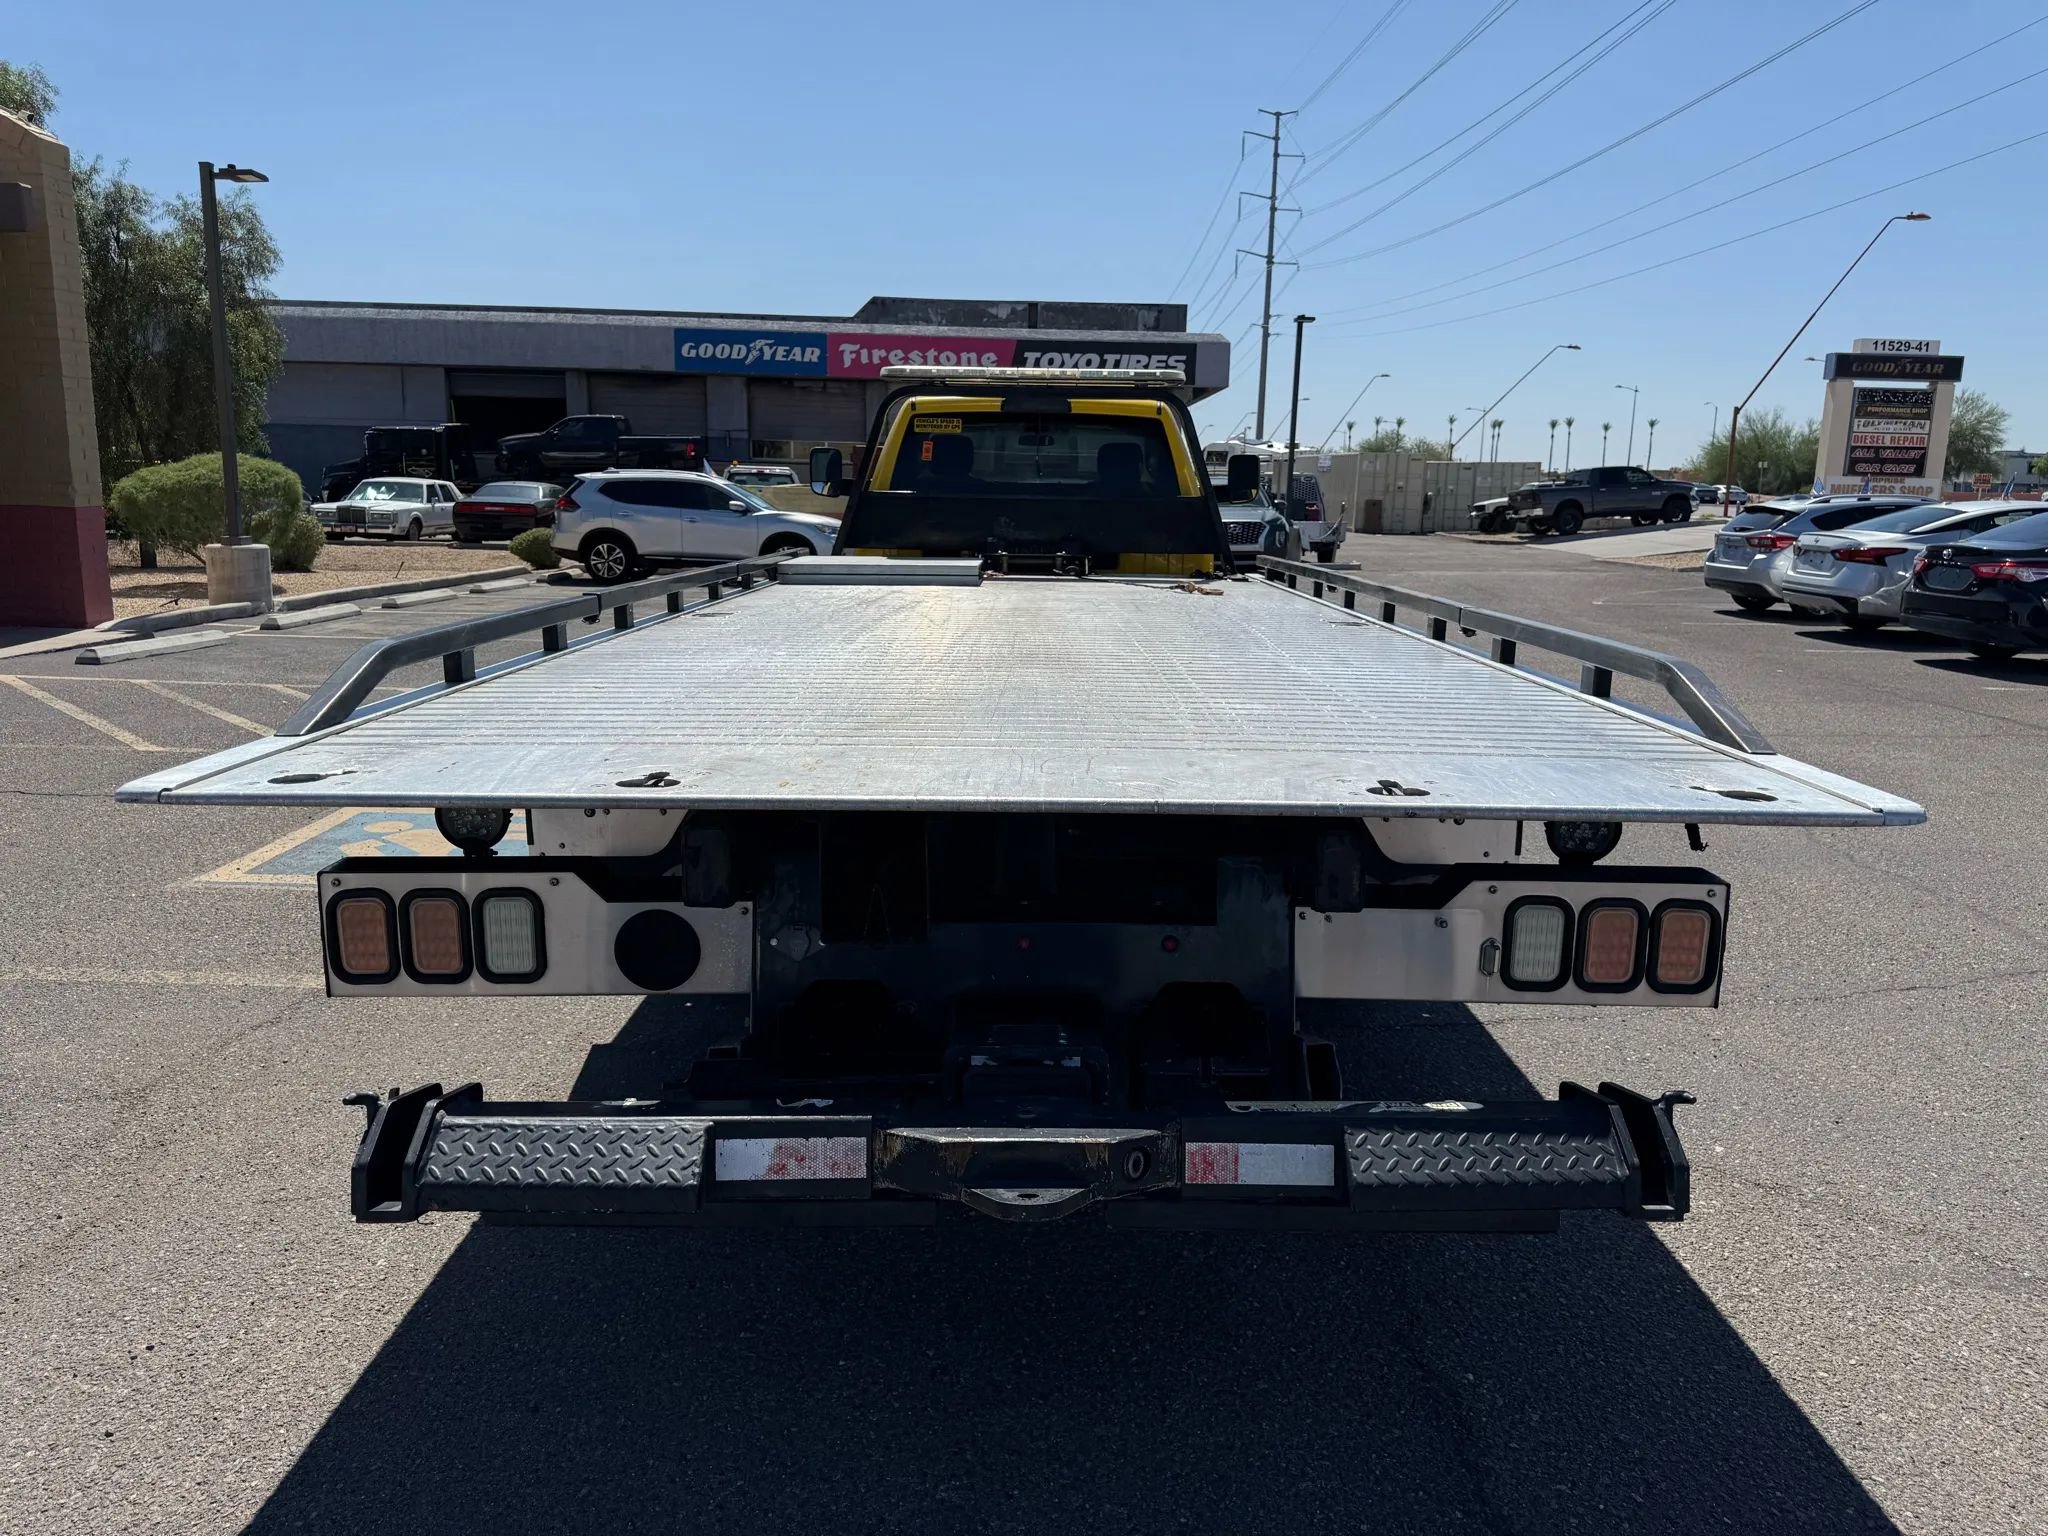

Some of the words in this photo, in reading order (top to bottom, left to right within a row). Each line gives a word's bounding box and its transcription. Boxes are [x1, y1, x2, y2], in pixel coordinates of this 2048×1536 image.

[1872, 340, 1930, 353] 11529-41
[839, 343, 999, 369] Firestone
[1023, 351, 1101, 370] TOYO
[1103, 353, 1187, 371] TIRES
[1853, 434, 1886, 445] DIESEL
[1890, 435, 1926, 446] REPAIR
[1851, 448, 1876, 458] ALL
[1879, 449, 1925, 459] VALLEY
[1855, 463, 1881, 473] CAR
[1882, 464, 1916, 474] CARE
[1899, 485, 1934, 497] SHOP
